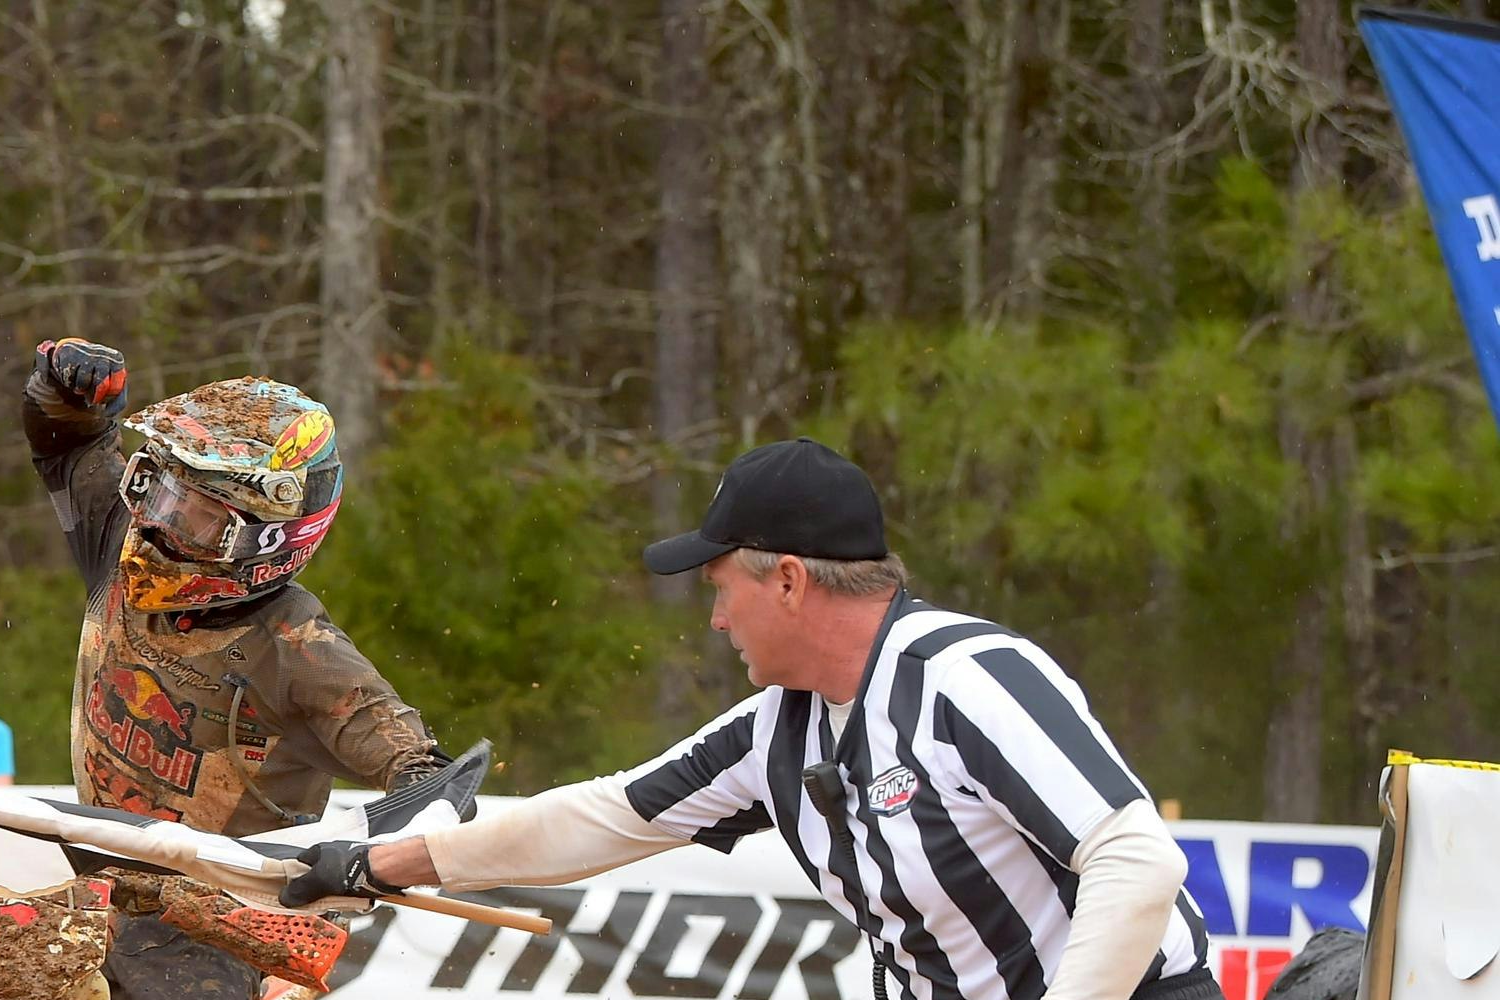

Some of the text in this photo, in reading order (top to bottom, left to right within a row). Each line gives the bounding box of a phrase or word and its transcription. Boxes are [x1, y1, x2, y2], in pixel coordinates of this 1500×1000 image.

[251, 549, 299, 587] Red
[86, 680, 197, 791] Red Bull
[870, 773, 916, 804] GNCC
